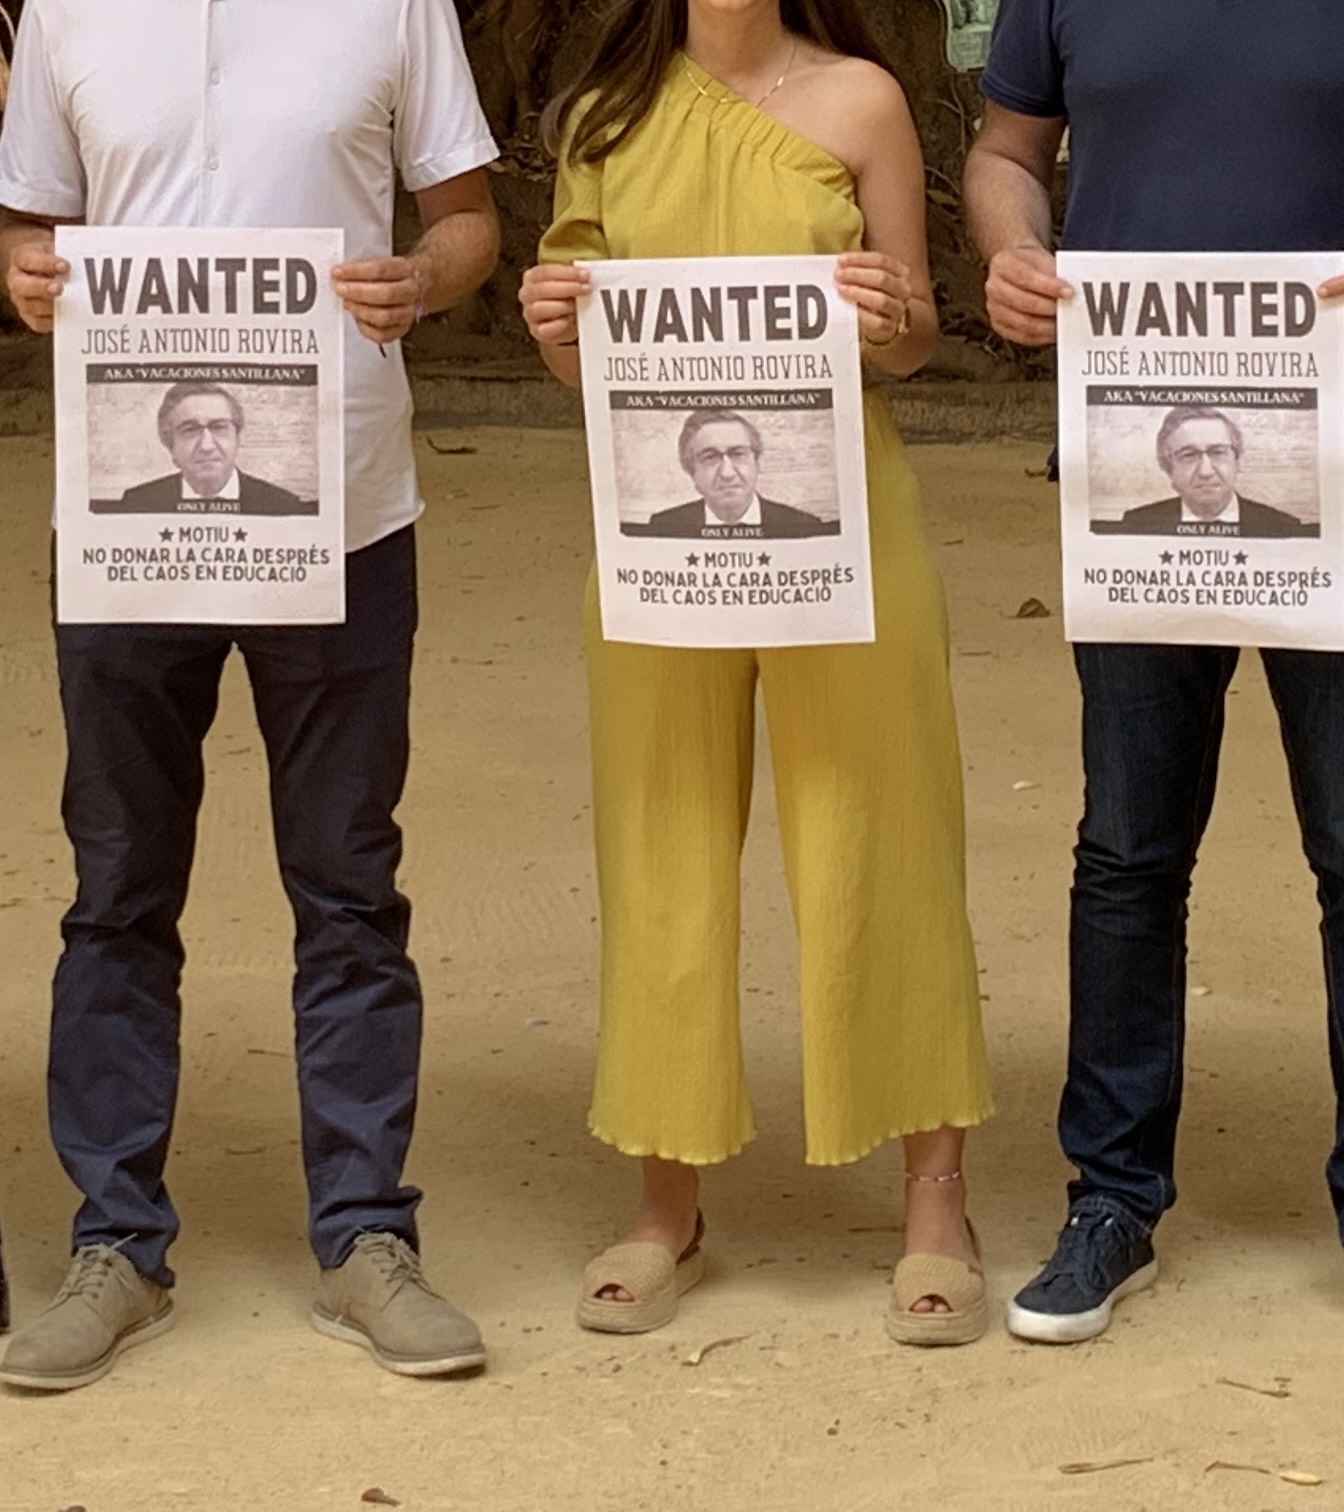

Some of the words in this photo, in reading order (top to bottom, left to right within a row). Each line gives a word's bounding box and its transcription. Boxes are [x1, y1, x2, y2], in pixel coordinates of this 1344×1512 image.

[83, 257, 318, 315] WANTED
[600, 283, 829, 344] WANTED
[1082, 281, 1317, 338] WANTED
[80, 323, 131, 355] JOSÉ
[138, 327, 230, 354] ANTONIO
[237, 328, 320, 355] ROVIRA
[603, 351, 650, 382] JOSÉ
[657, 355, 746, 382] ANTONIO
[751, 353, 834, 381] ROVIRA
[1081, 345, 1131, 376] JOSÉ
[1137, 350, 1229, 377] ANTONIO
[1235, 351, 1320, 378] ROVIRA
[104, 368, 134, 379] AKA
[626, 395, 654, 406] AKA
[1104, 390, 1133, 402] AKA
[1134, 390, 1219, 403] "VACACIONES
[1220, 392, 1305, 404] SANTILLANA"
[178, 526, 230, 543] MOTIU
[82, 548, 107, 565] NO
[111, 547, 171, 564] DONAR
[175, 547, 197, 563] LA
[200, 547, 248, 564] CARA
[252, 543, 331, 566] DESPRÉS
[704, 551, 754, 569] MOTIU
[1178, 549, 1230, 566] MOTIU
[107, 565, 138, 582] DEL
[143, 565, 191, 581] CAOS
[195, 564, 217, 581] EN
[222, 563, 307, 583] EDUCACIÓ
[616, 568, 639, 585] NO
[642, 569, 698, 588] DONAR
[702, 572, 723, 588] LA
[726, 571, 773, 588] CARA
[777, 563, 854, 587] DESPRÉS
[1084, 568, 1108, 585] NO
[1112, 568, 1171, 586] DONAR
[1176, 570, 1197, 587] LA
[1200, 570, 1249, 587] CARA
[1253, 566, 1332, 589] DESPRÉS
[639, 586, 668, 605] DEL
[672, 588, 717, 606] CAOS
[721, 589, 744, 606] EN
[747, 583, 832, 606] EDUCACIÓ
[1108, 586, 1139, 604] DEL
[1143, 587, 1190, 606] CAOS
[1195, 588, 1218, 606] EN
[1222, 586, 1309, 607] EDUCACIÓ
